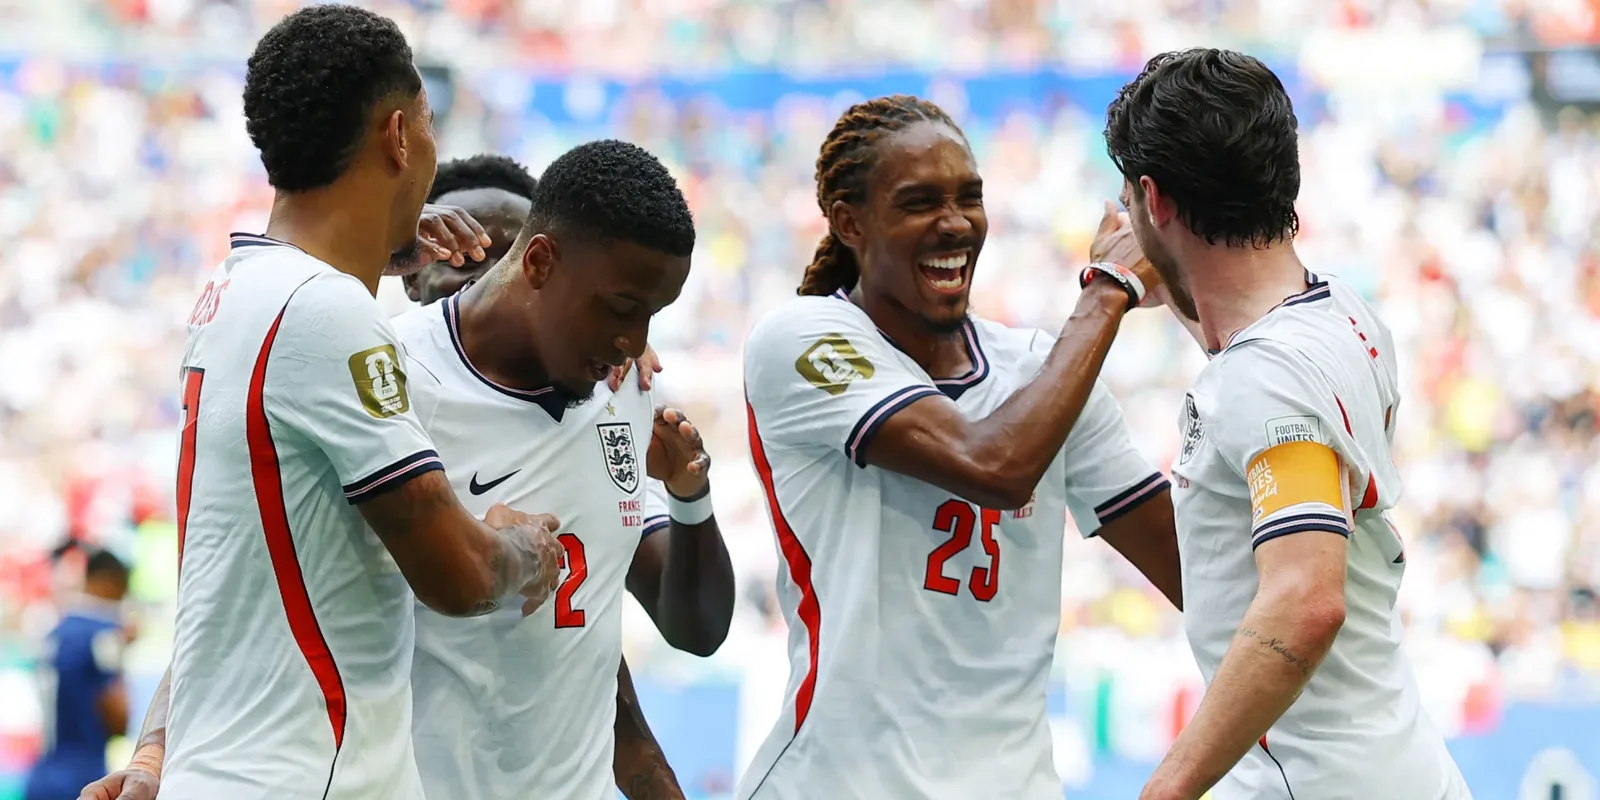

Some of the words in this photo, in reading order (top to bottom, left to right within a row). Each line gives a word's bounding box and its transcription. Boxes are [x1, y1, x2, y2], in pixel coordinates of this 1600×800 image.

[1275, 424, 1313, 435] FOOTBALL
[618, 501, 641, 512] FRANCE
[923, 498, 1001, 602] 25
[554, 532, 588, 629] 2
